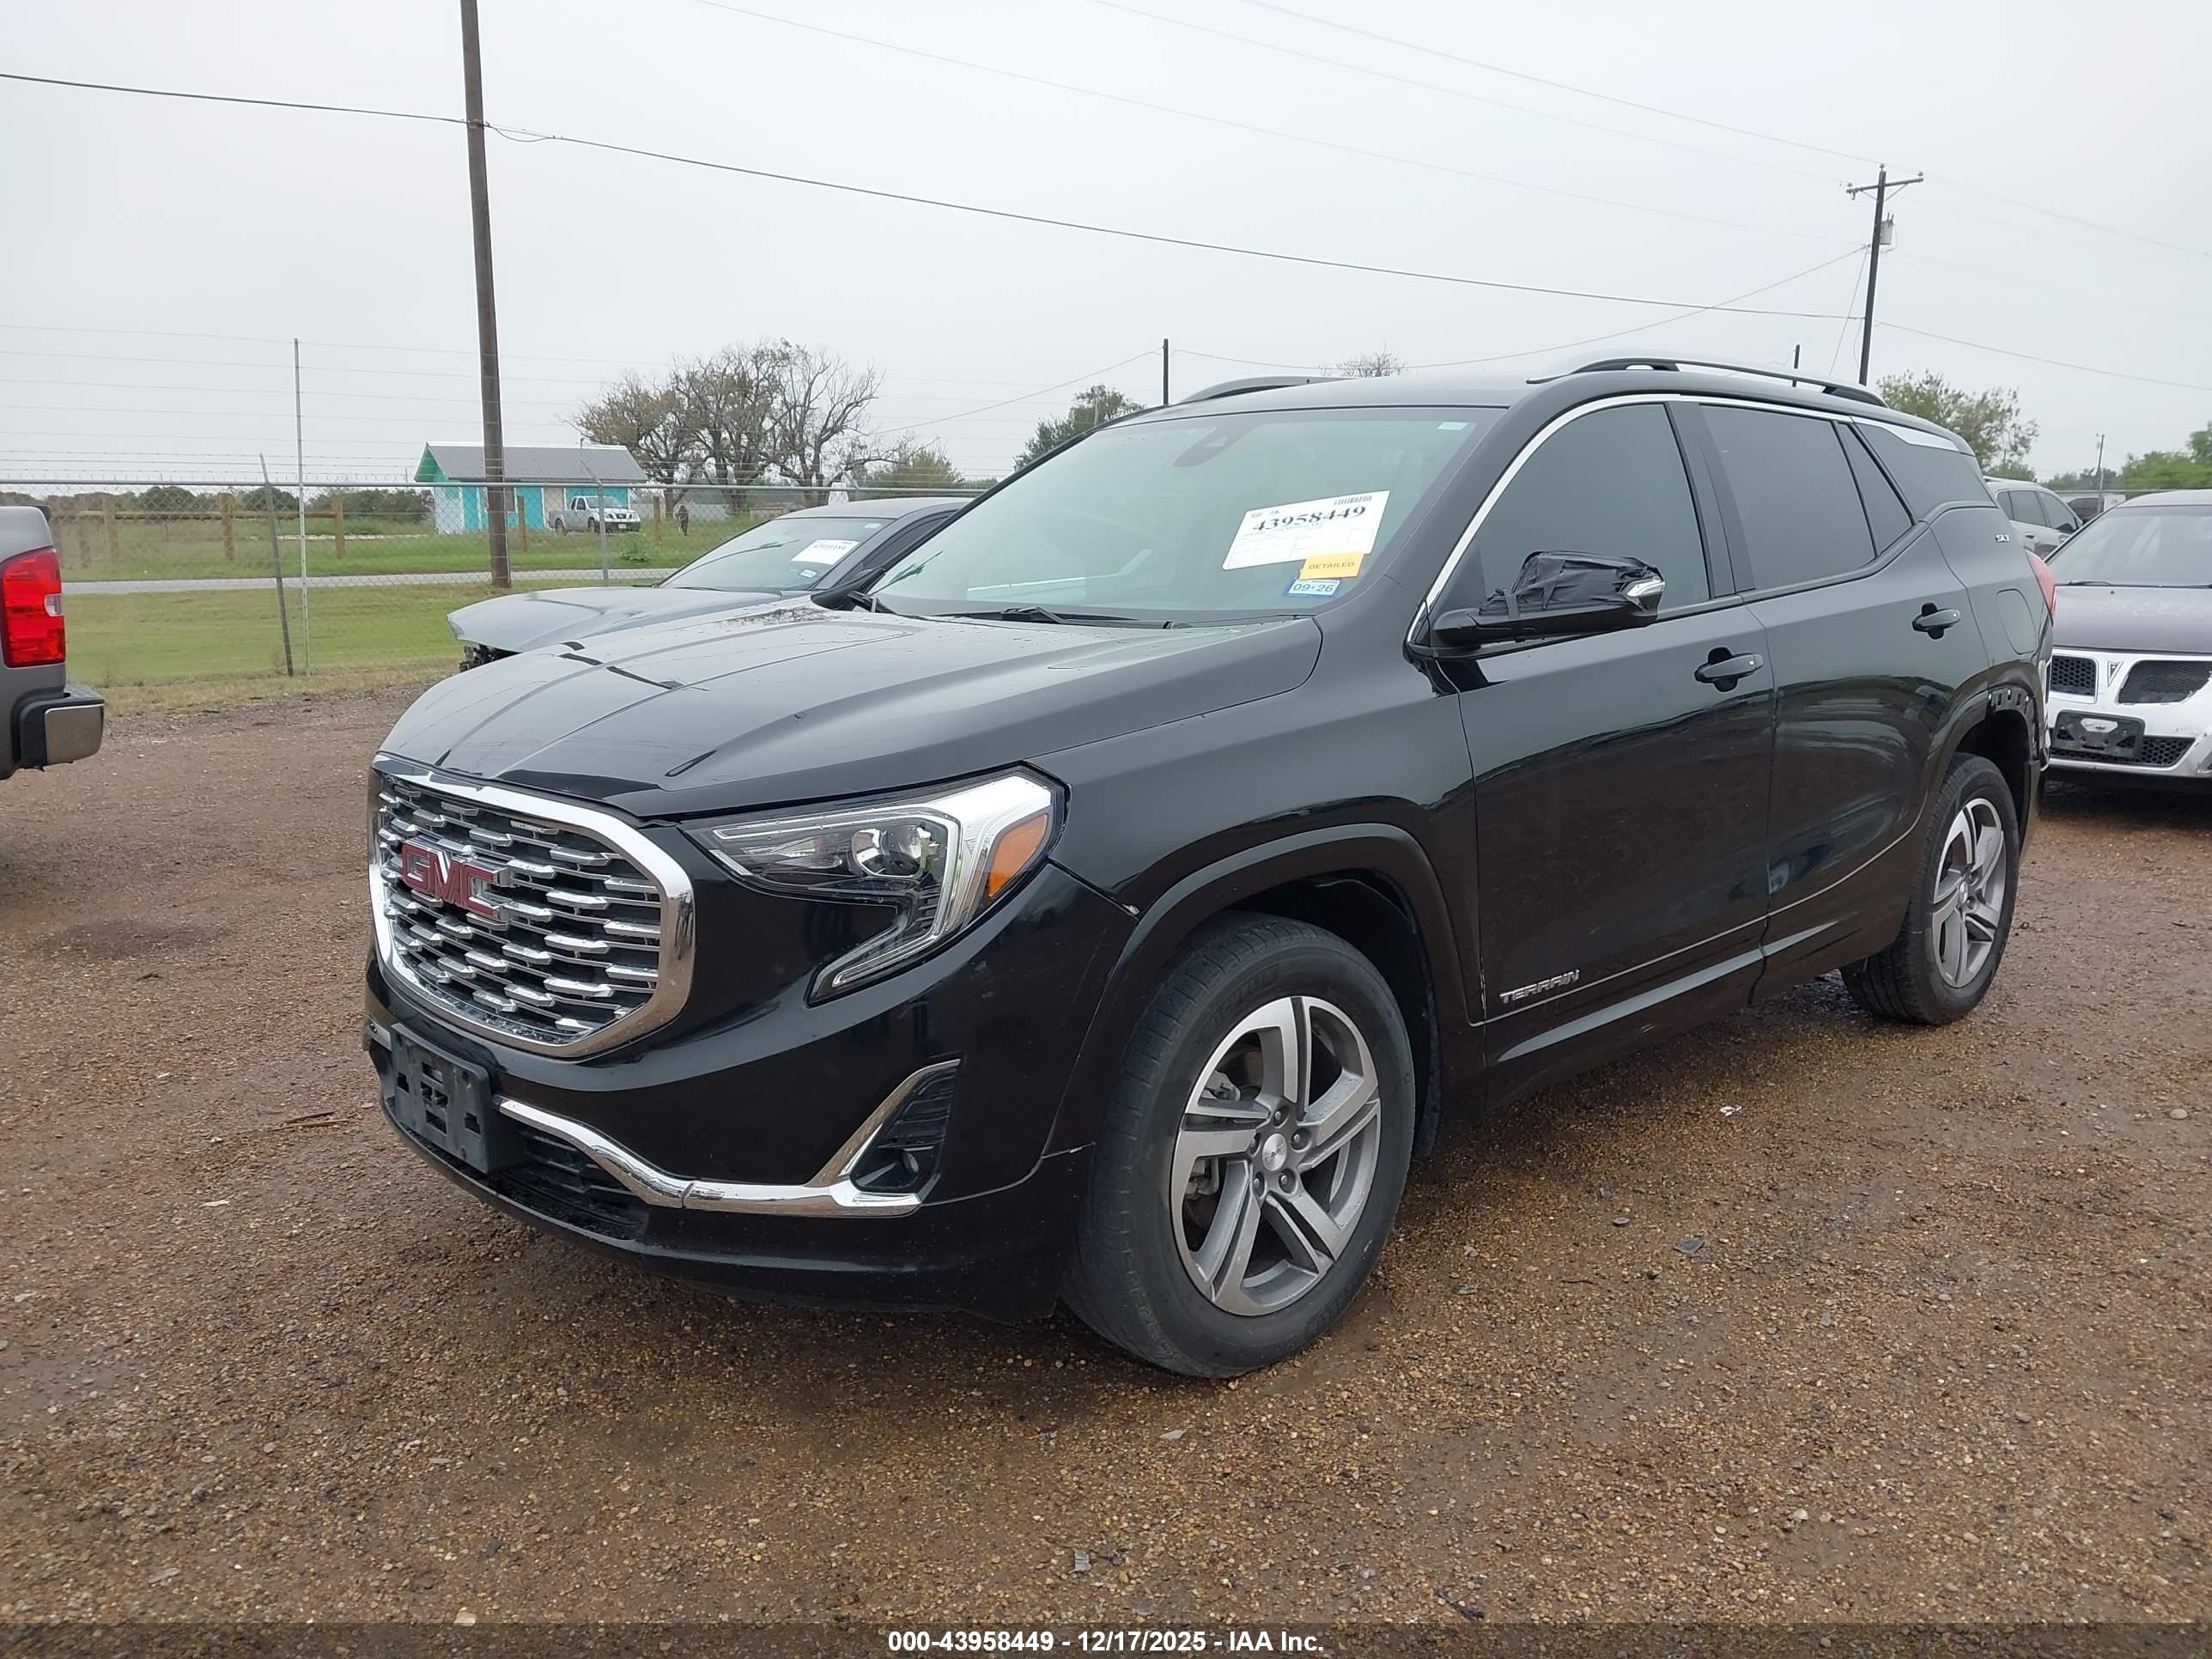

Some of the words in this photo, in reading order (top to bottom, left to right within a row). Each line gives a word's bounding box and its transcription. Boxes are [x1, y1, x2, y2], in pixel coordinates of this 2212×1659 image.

[1252, 505, 1367, 531] 43958449
[1308, 562, 1355, 570] DETAILED
[401, 839, 505, 922] GMC
[1498, 969, 1580, 1004] TERRAIN
